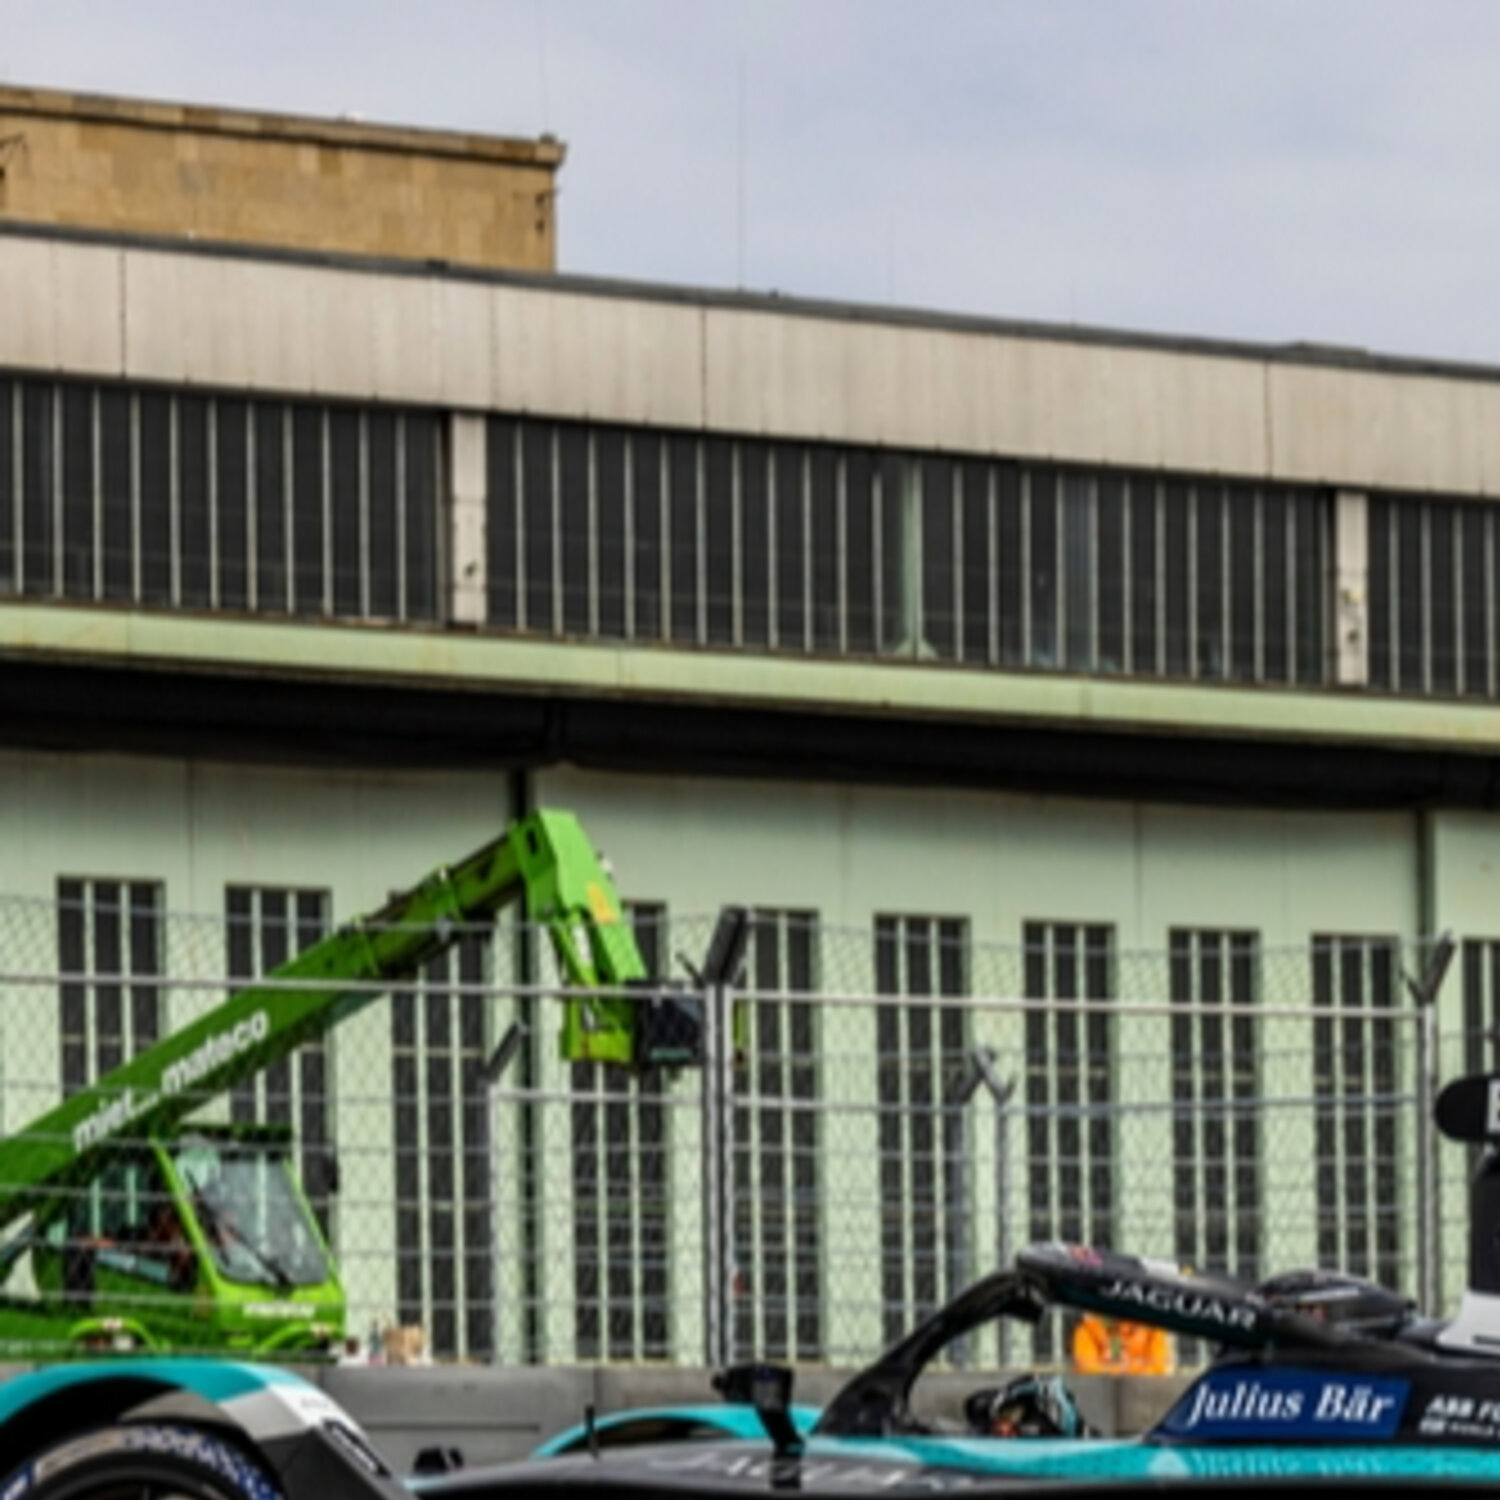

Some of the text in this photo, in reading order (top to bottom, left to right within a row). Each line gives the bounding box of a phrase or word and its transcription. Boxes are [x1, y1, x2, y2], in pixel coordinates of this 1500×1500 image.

[1102, 1281, 1258, 1331] JAGUAR
[1189, 1381, 1396, 1427] Julius Bär
